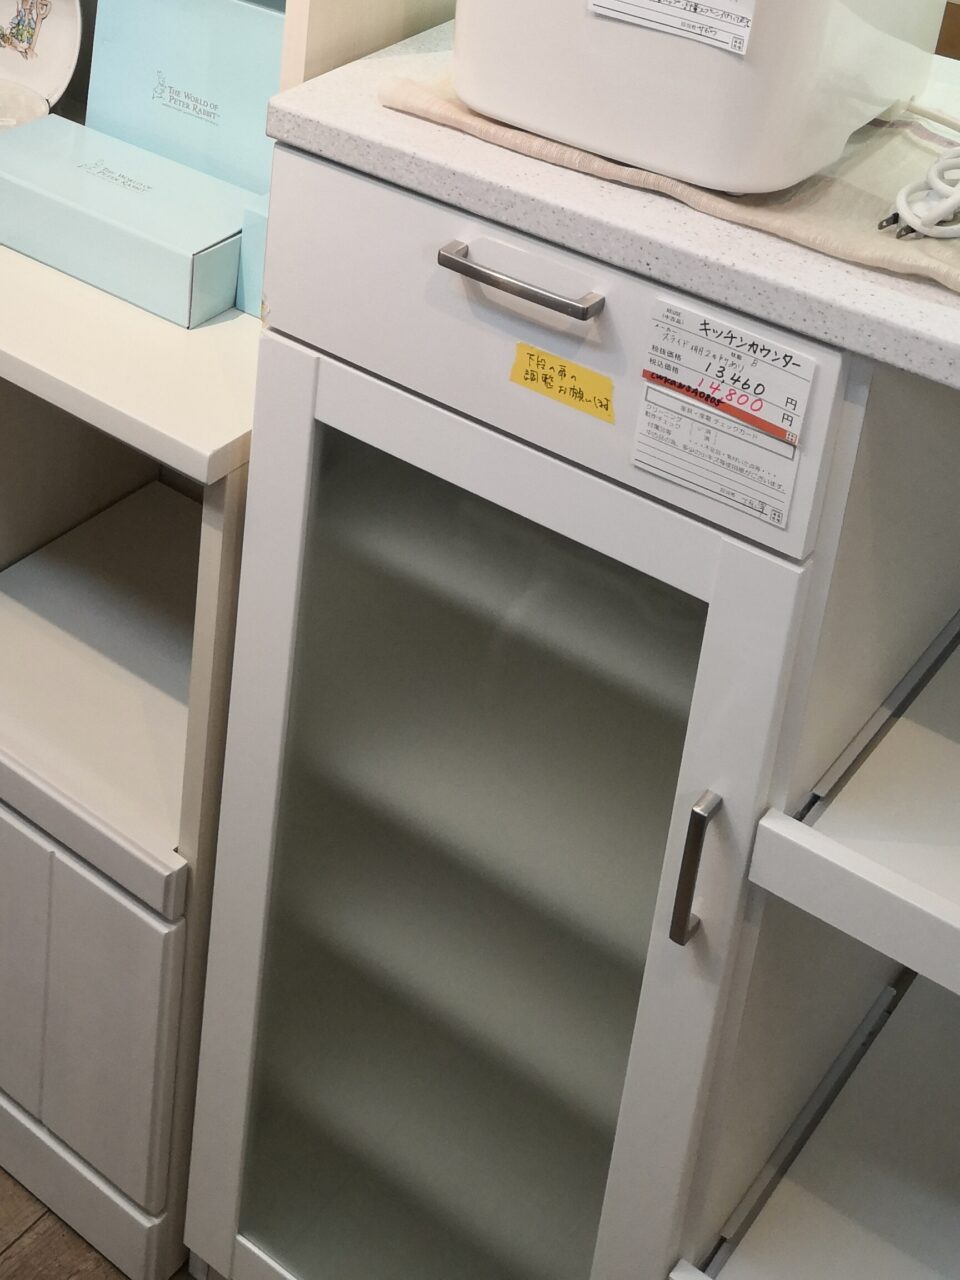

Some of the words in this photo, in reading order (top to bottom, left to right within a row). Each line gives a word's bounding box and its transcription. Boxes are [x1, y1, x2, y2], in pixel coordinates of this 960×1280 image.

[699, 320, 801, 368] キッチンカウンター
[697, 377, 764, 412] 14,800
[781, 412, 794, 427] 円
[705, 362, 765, 396] 13,460
[785, 396, 798, 411] 円
